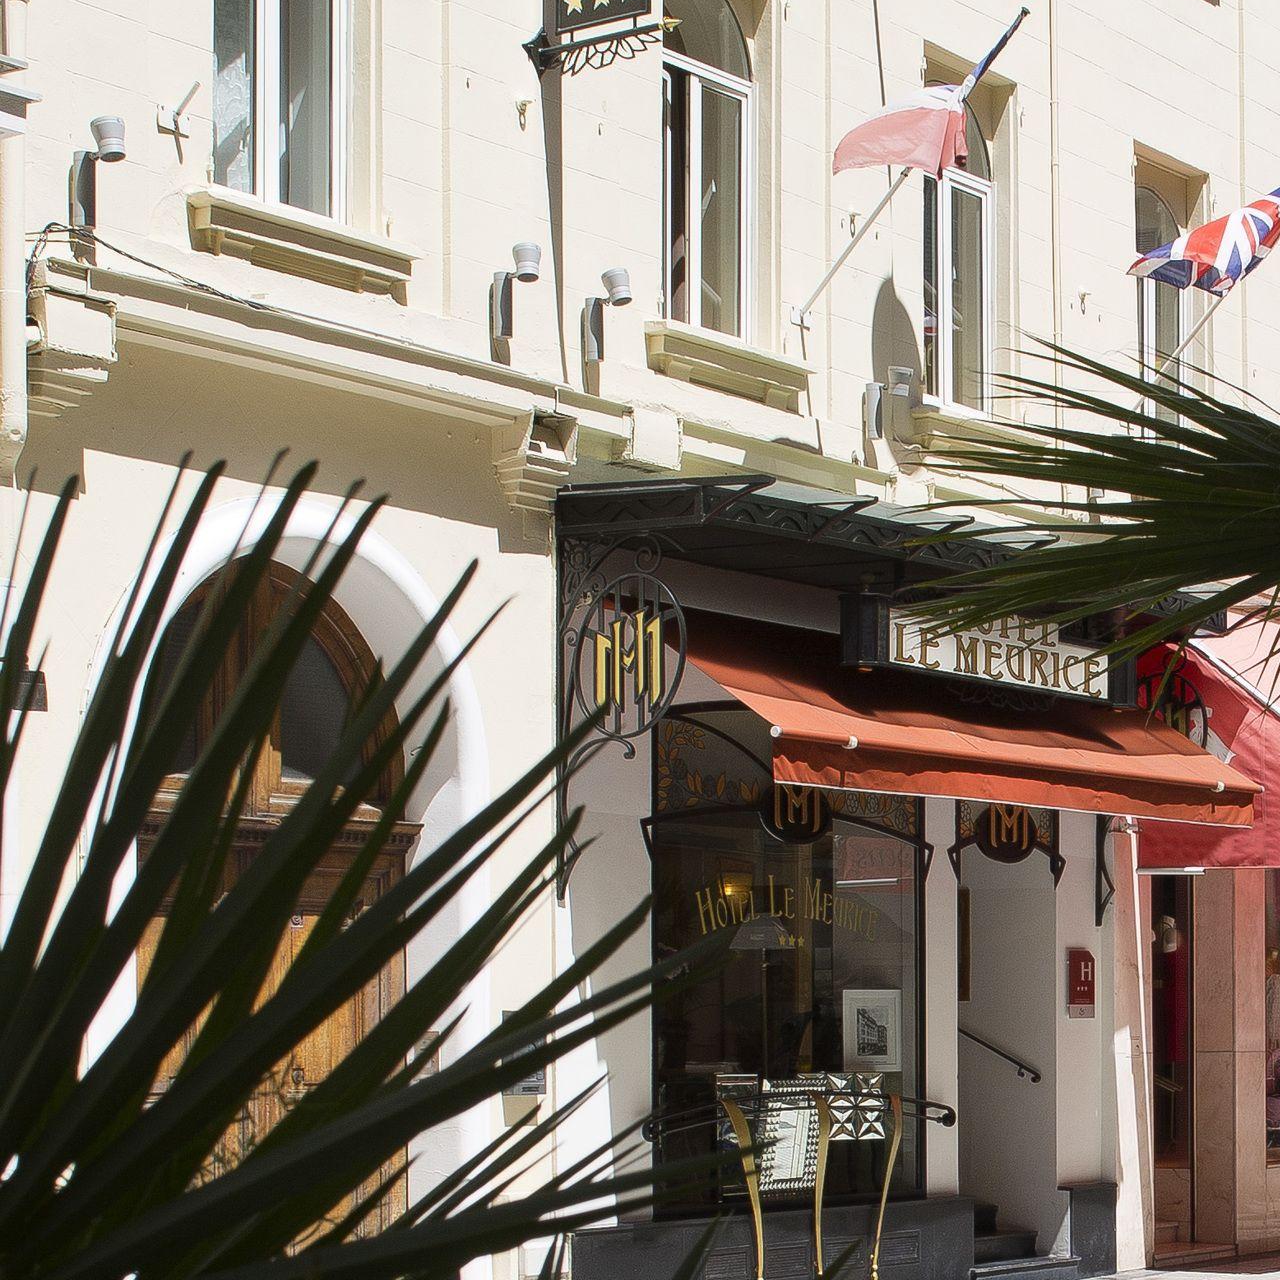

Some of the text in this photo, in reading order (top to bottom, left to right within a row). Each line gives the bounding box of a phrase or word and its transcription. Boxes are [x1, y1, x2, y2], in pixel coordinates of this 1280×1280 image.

[894, 622, 1102, 699] LE MEURICE
[1081, 961, 1092, 981] H
